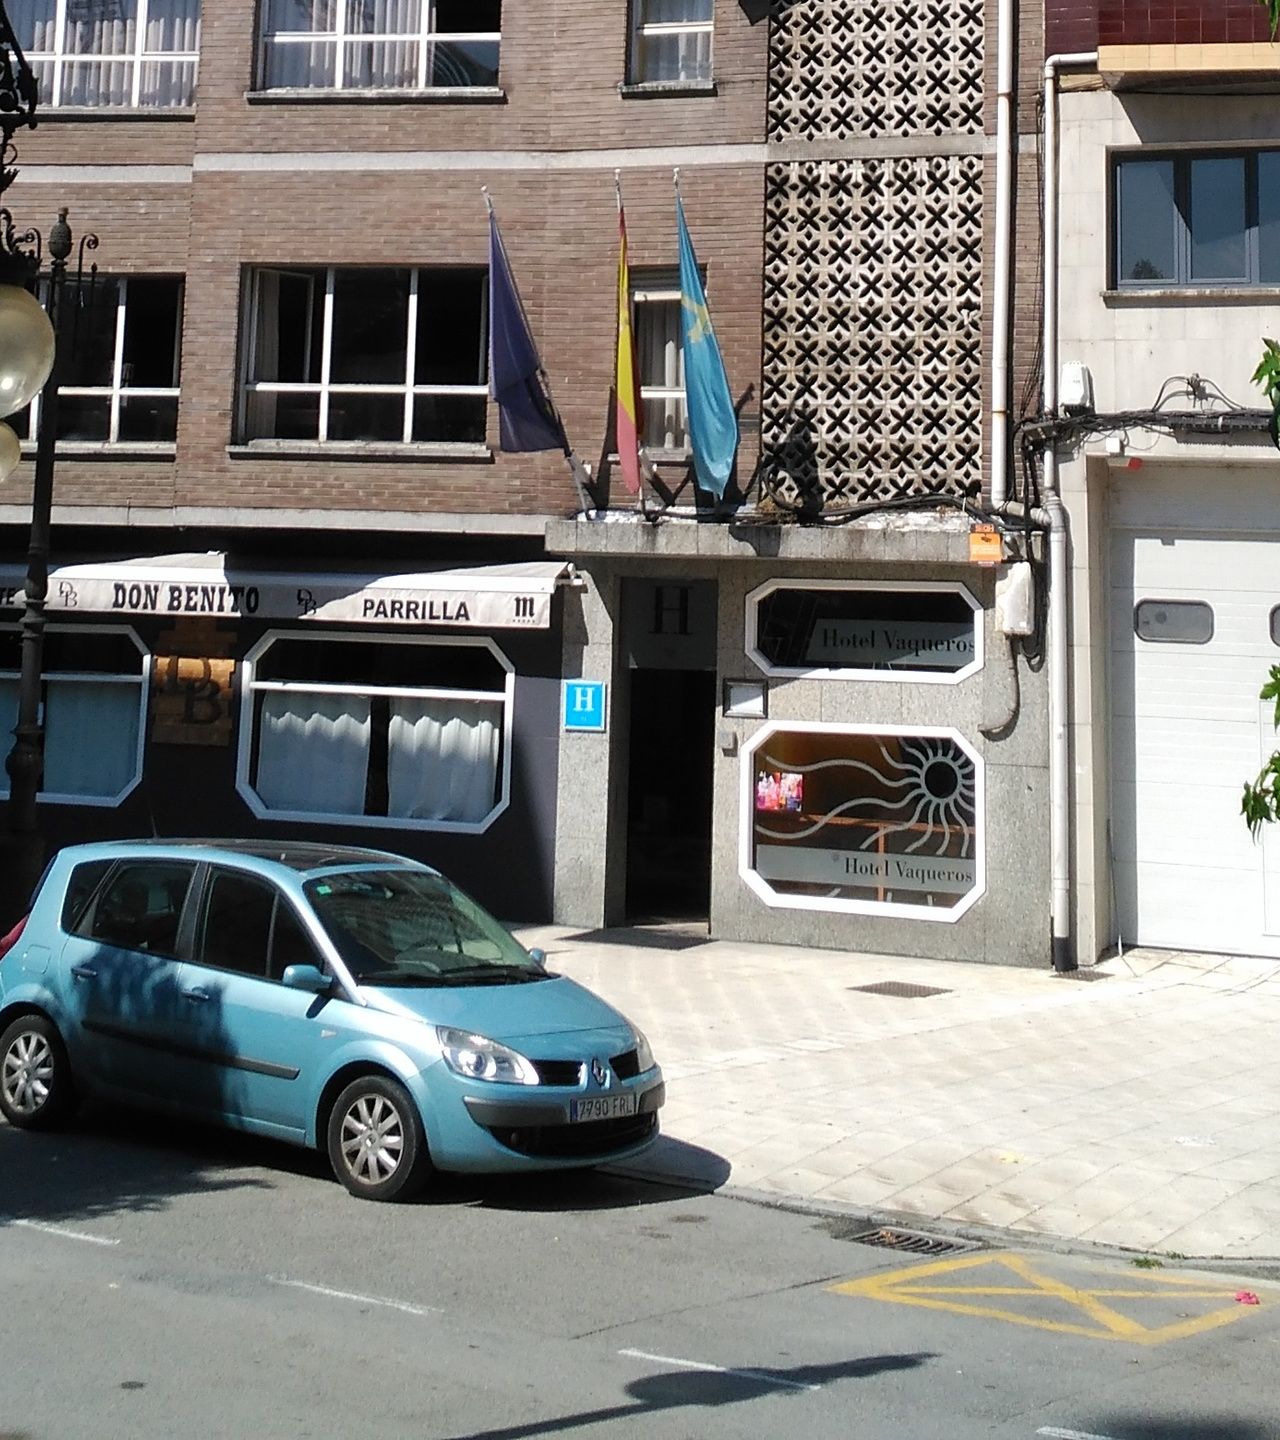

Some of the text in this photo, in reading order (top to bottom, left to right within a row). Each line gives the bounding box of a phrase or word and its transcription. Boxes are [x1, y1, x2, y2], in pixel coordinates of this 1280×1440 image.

[112, 582, 160, 610] DON
[167, 583, 260, 614] BENITO
[362, 597, 471, 622] PARRILLA
[648, 586, 694, 636] H
[822, 628, 974, 657] Hotel Vaqueros
[573, 686, 595, 712] H
[844, 856, 973, 884] Hotel Vaqueros
